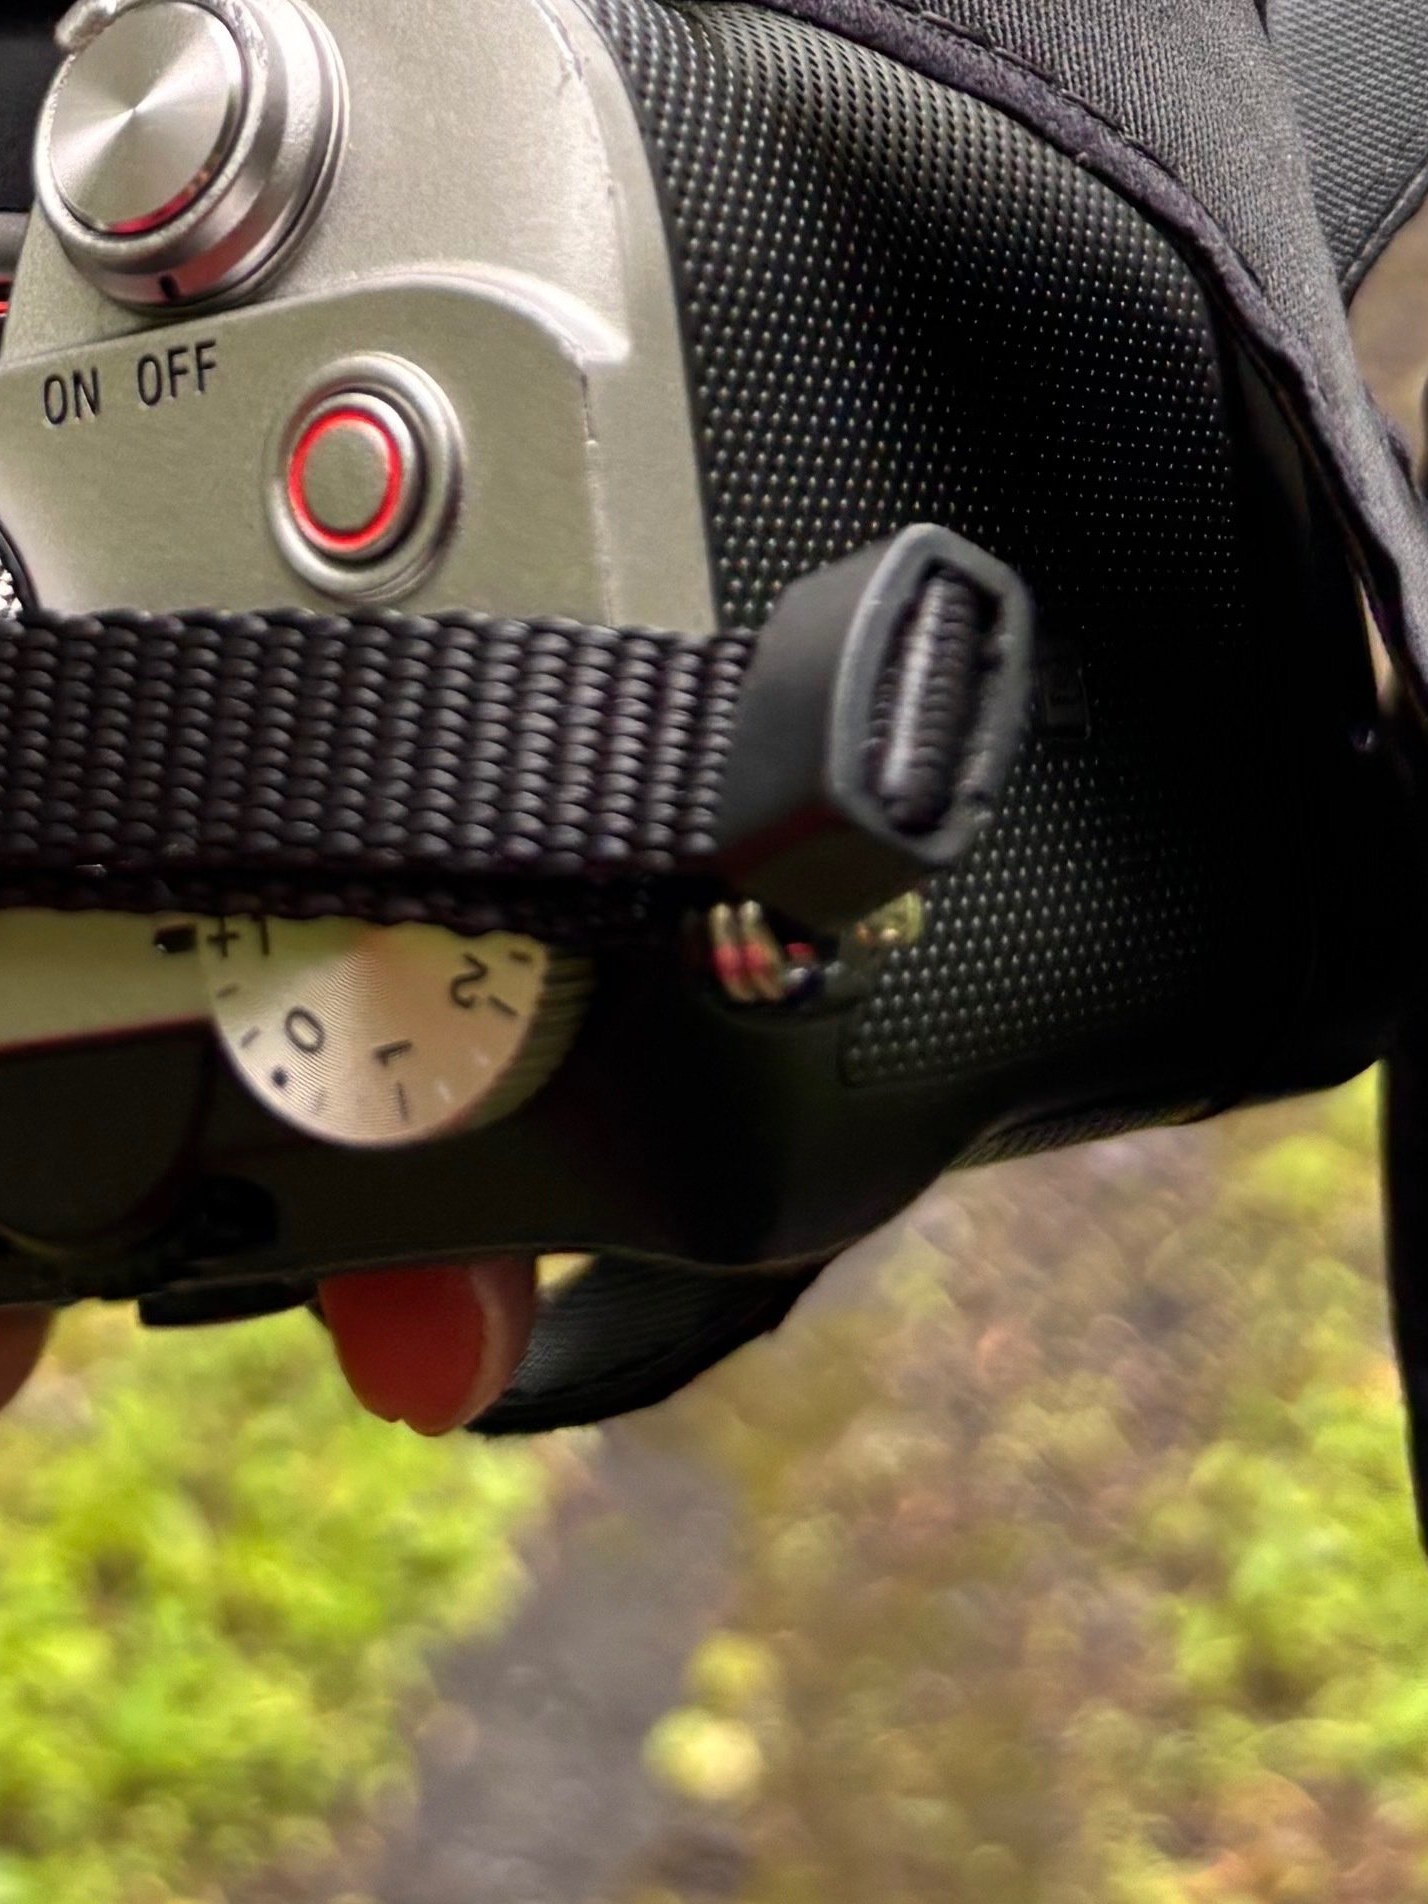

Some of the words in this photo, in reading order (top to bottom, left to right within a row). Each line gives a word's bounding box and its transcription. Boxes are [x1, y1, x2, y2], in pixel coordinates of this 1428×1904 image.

[42, 366, 103, 427] ON
[137, 339, 219, 408] OFF
[284, 1006, 327, 1055] 0
